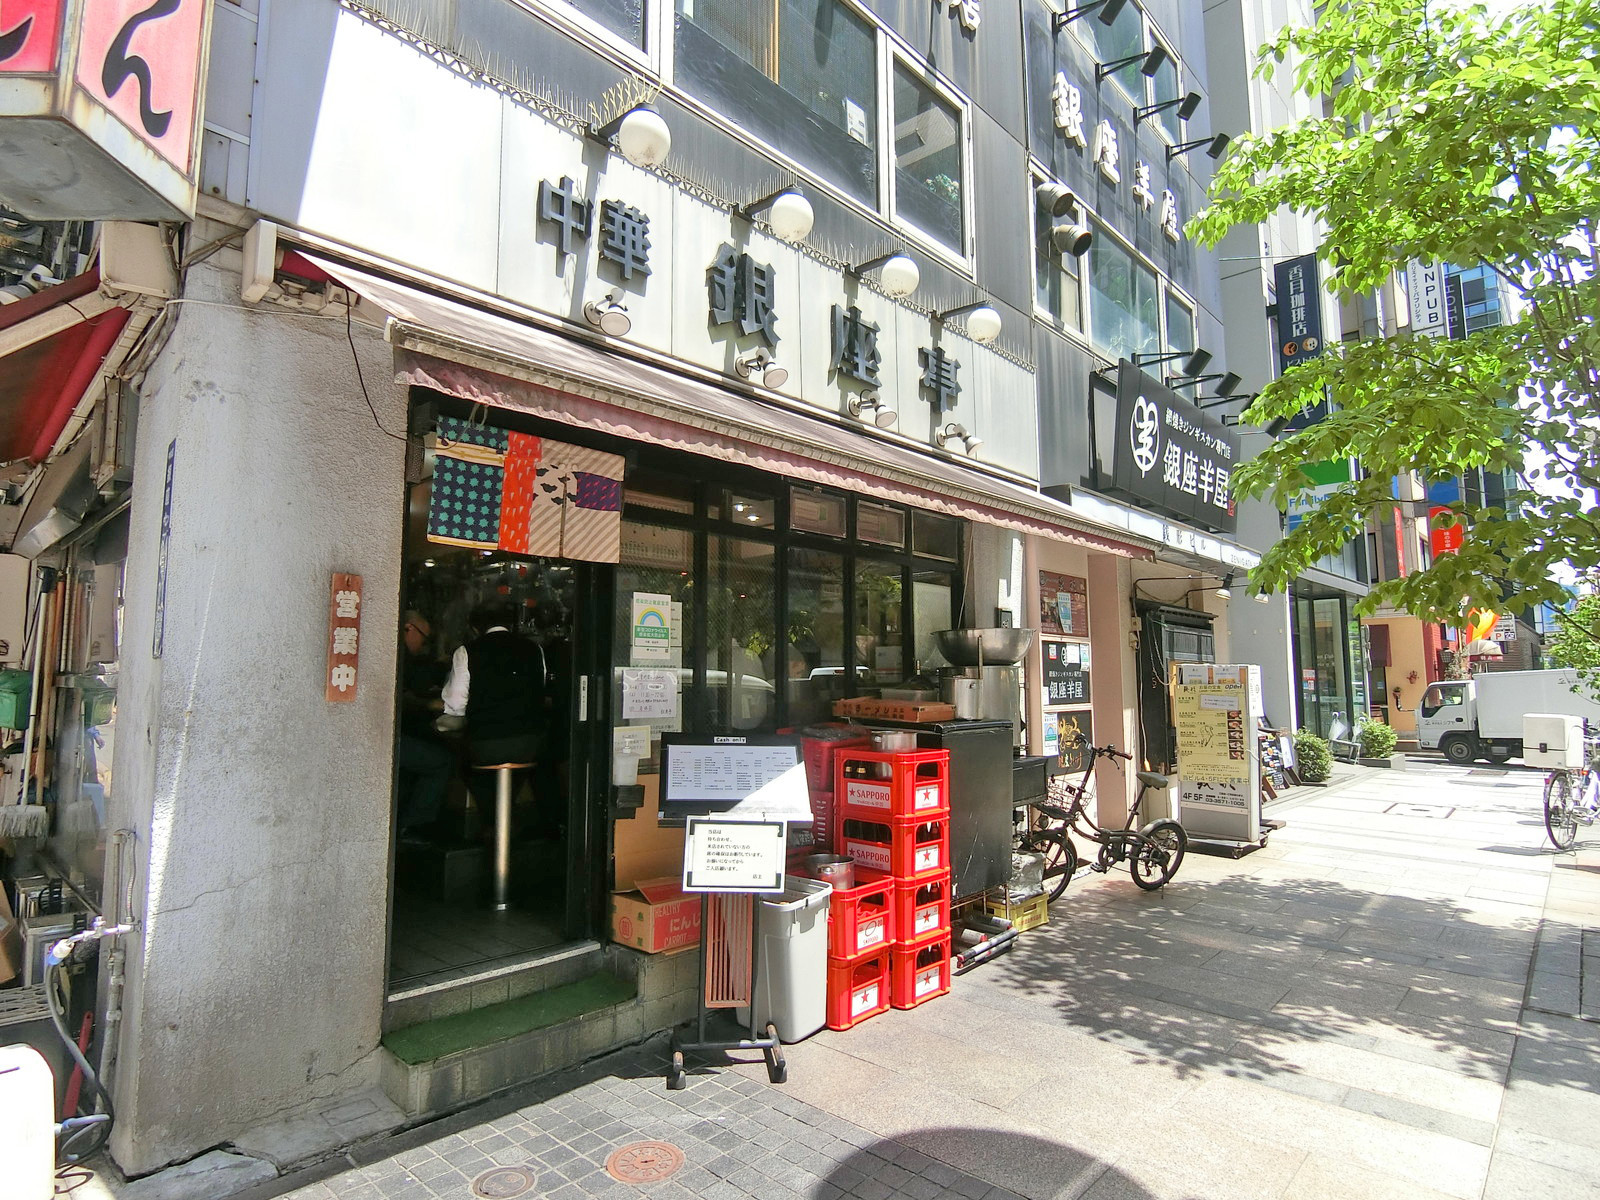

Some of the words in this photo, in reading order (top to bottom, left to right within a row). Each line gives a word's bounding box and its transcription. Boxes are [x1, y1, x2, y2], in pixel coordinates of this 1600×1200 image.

[538, 175, 652, 280] 中華
[1163, 438, 1229, 510] 銀座羊屋
[332, 588, 360, 693] 営業中
[1050, 680, 1083, 699] 銀座羊屋
[856, 789, 890, 801] SAPPORO
[1182, 792, 1192, 800] 4F
[1193, 793, 1203, 801] 5F
[856, 850, 890, 863] SAPPORO
